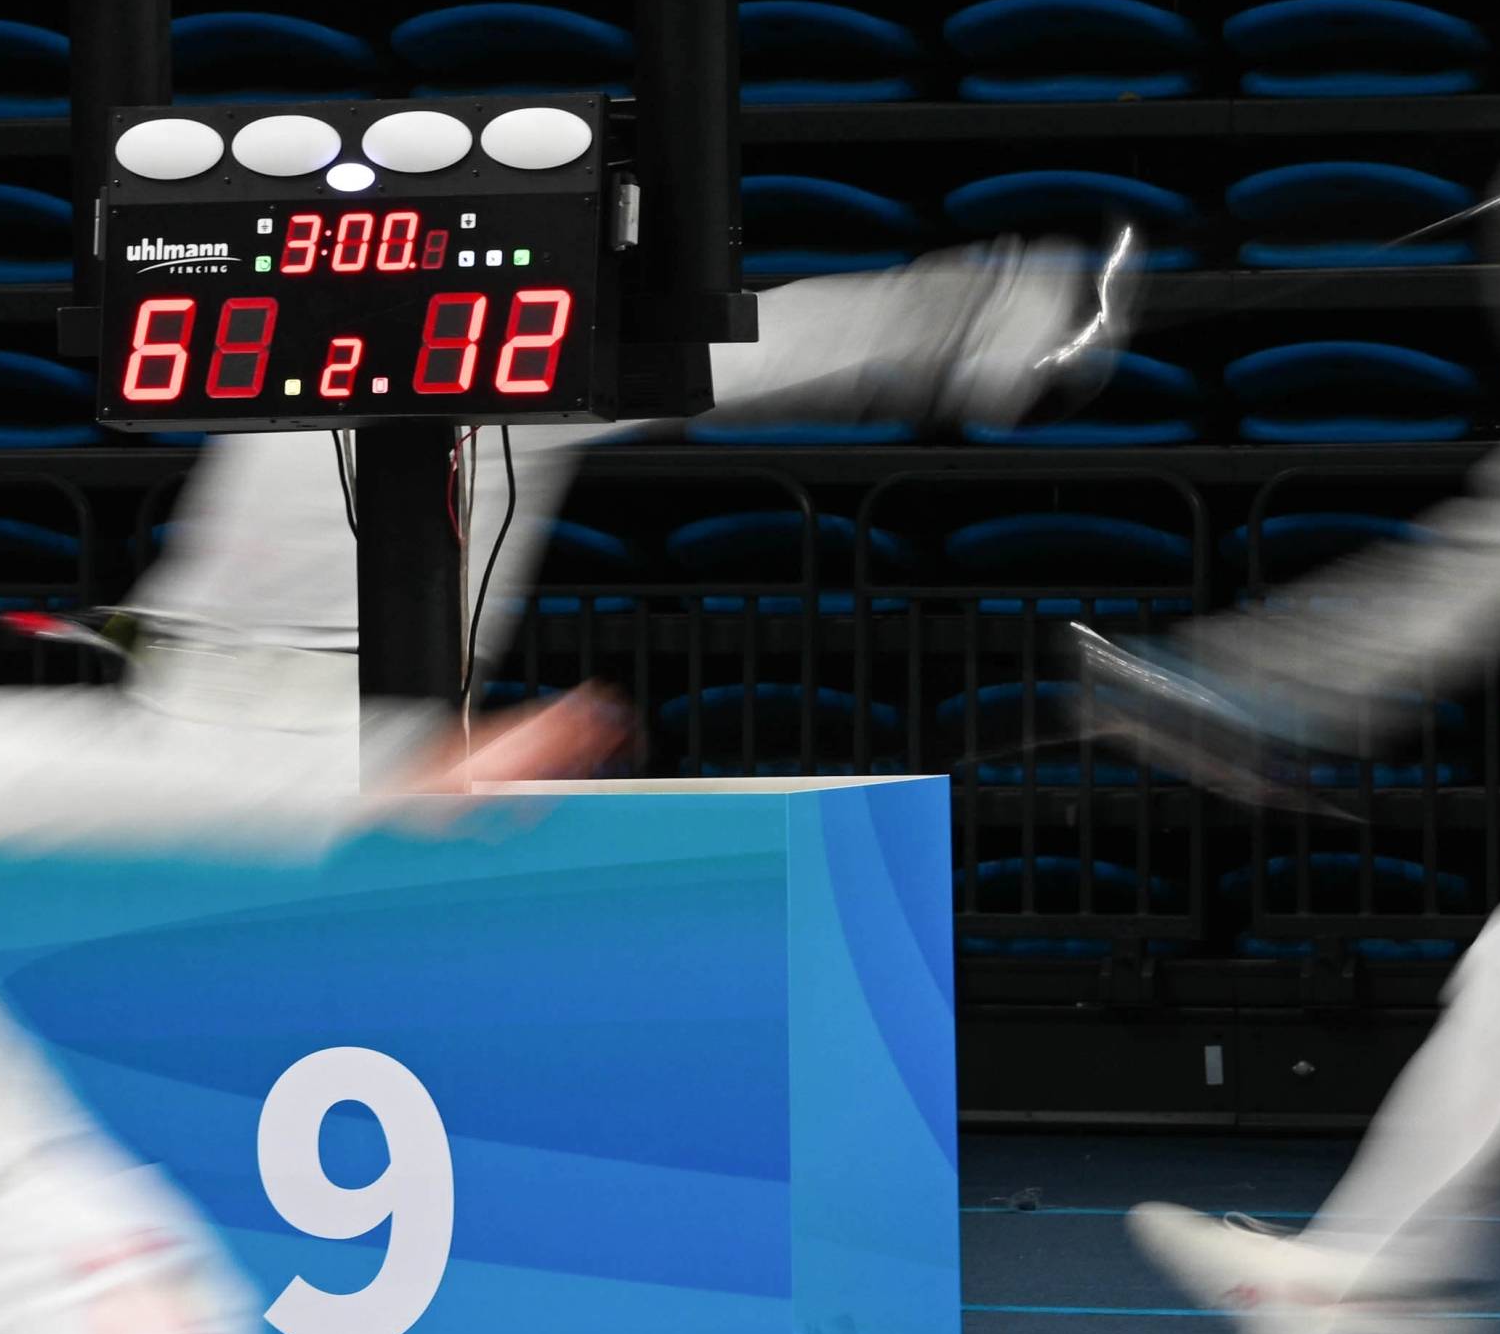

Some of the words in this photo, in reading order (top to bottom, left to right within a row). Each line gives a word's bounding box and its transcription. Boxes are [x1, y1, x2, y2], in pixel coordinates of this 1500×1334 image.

[126, 237, 229, 261] uhlmann
[169, 265, 228, 274] FENCING
[459, 287, 571, 394] 12
[319, 337, 363, 397] 2
